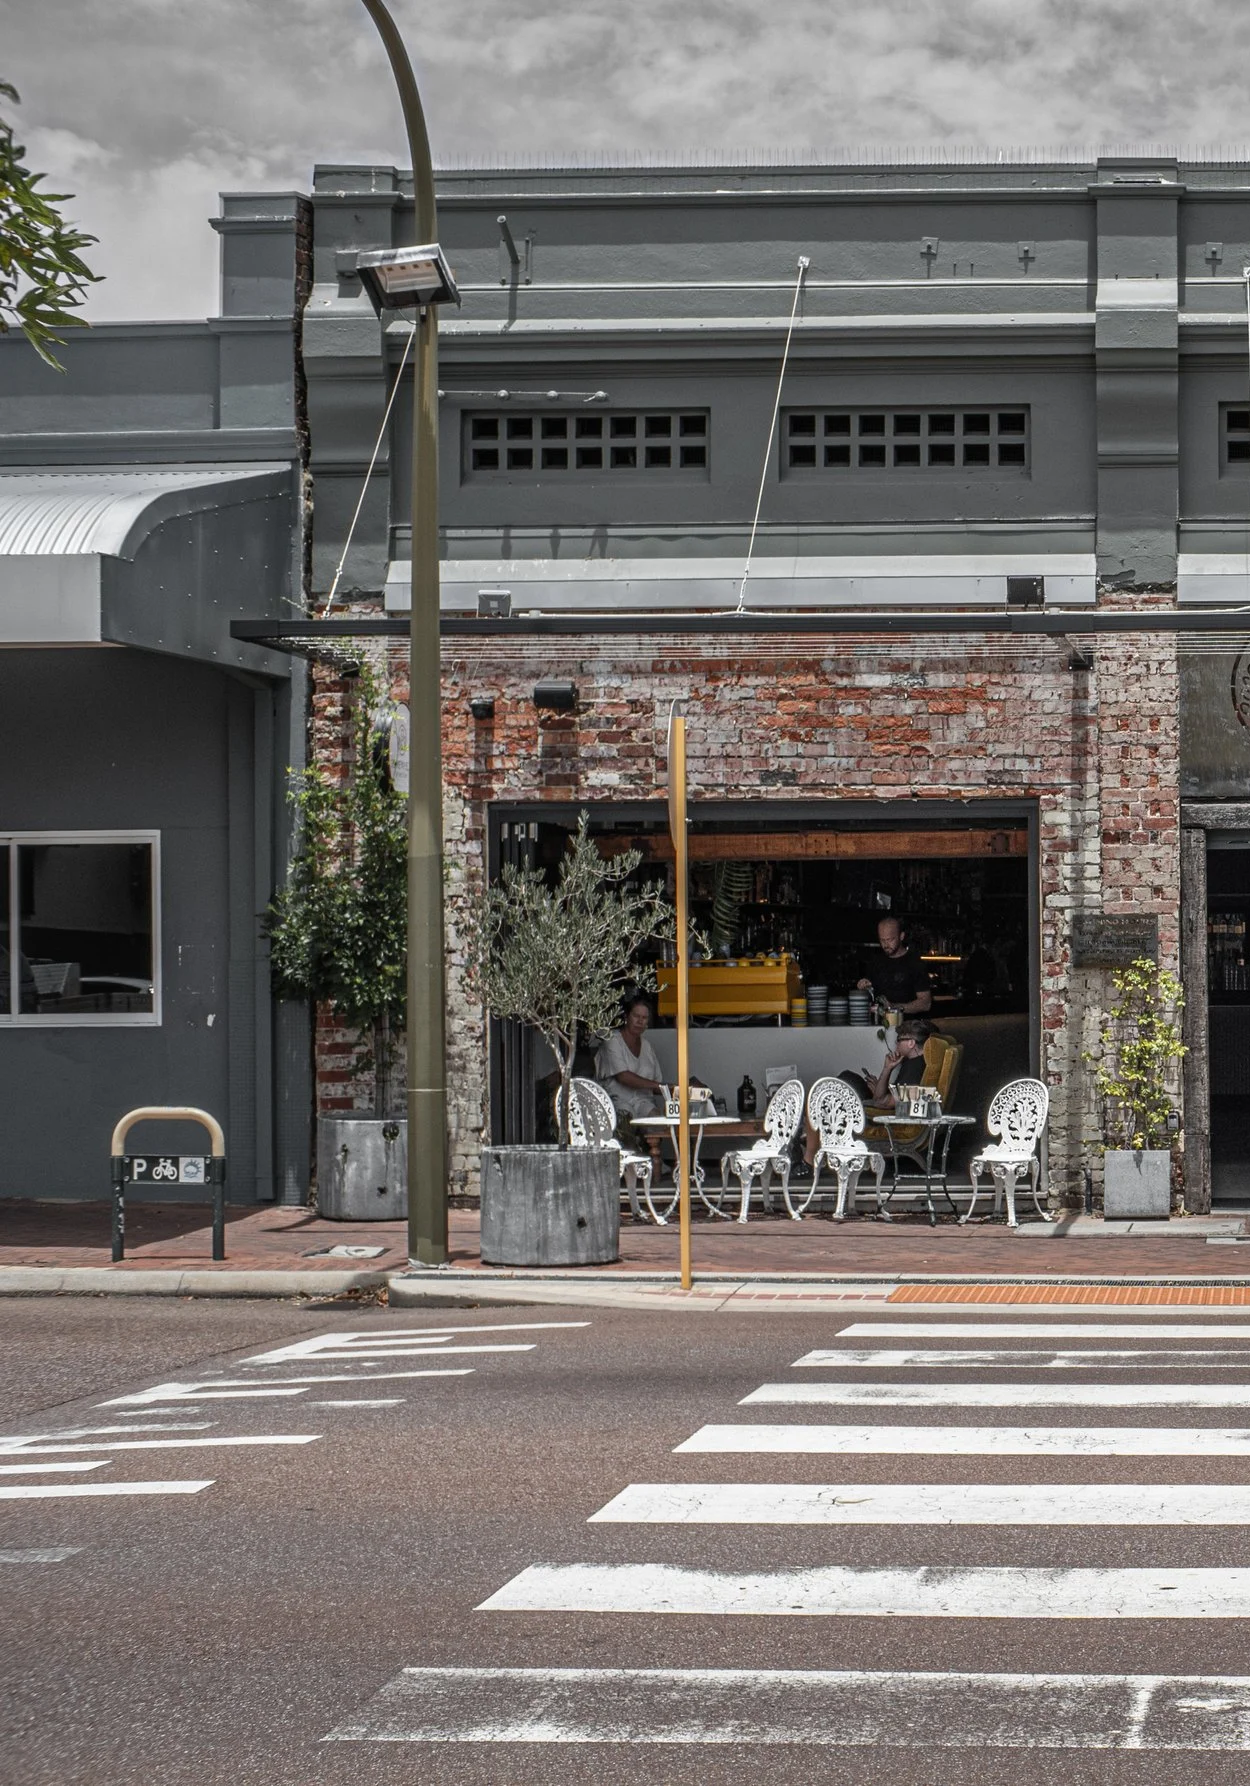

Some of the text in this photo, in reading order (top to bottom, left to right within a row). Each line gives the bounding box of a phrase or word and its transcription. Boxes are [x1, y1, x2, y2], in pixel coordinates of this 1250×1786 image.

[668, 1103, 680, 1115] 80
[913, 1102, 926, 1115] 81
[133, 1158, 147, 1180] P
